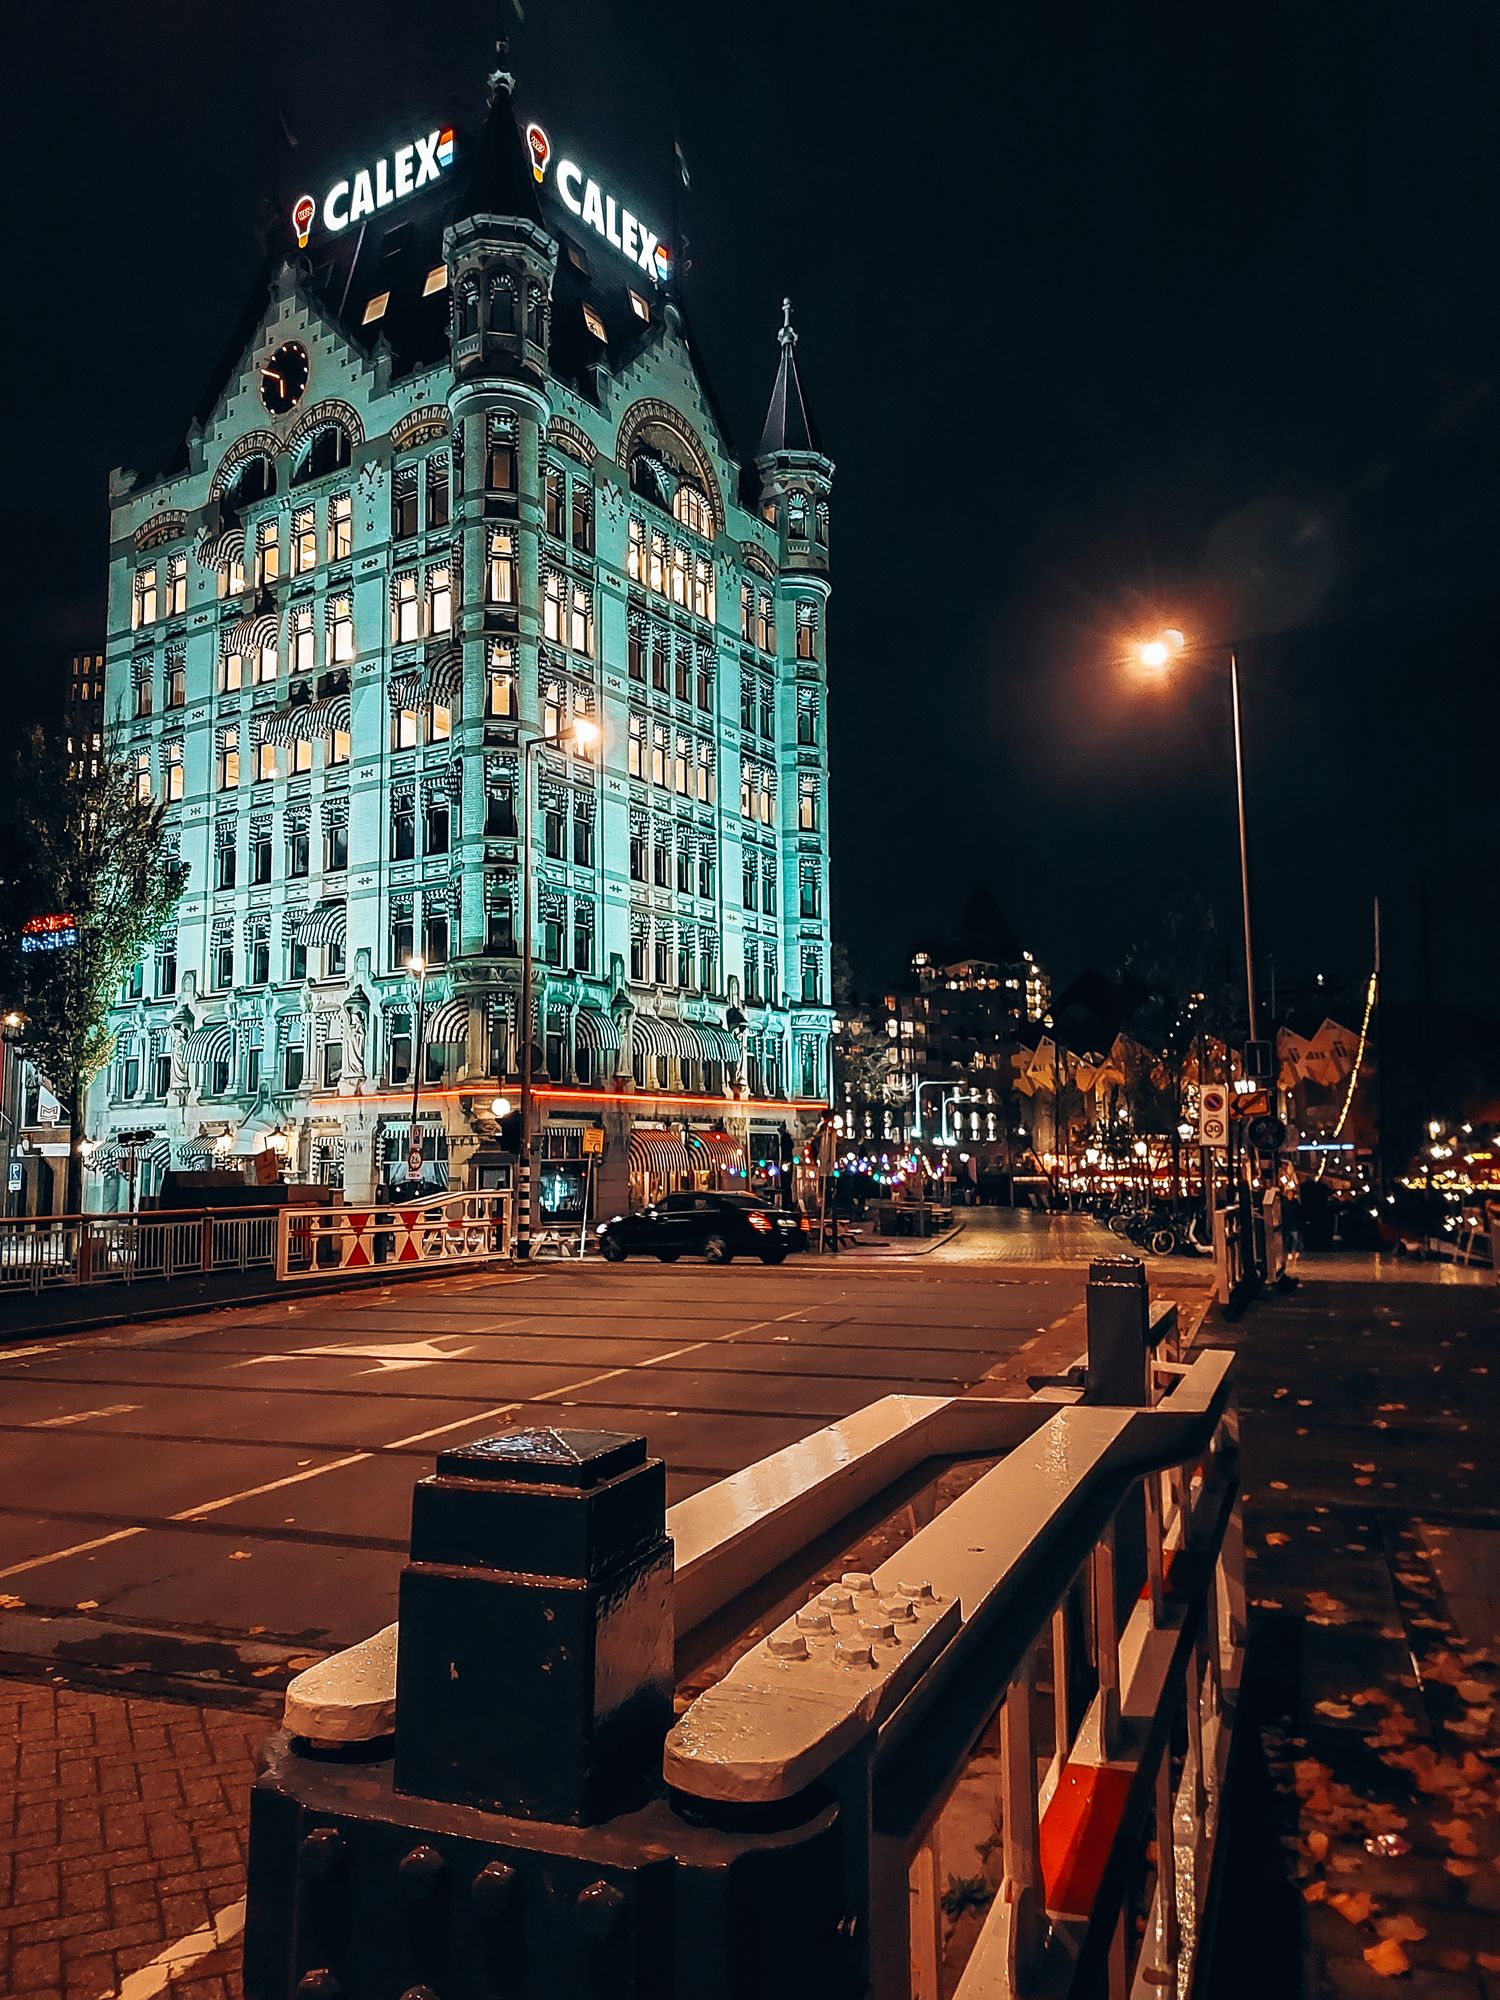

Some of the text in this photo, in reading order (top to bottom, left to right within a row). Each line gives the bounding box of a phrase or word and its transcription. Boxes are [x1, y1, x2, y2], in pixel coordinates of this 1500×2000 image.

[323, 130, 442, 232] CALEX
[556, 159, 659, 279] CALEX
[1208, 1124, 1220, 1133] 30
